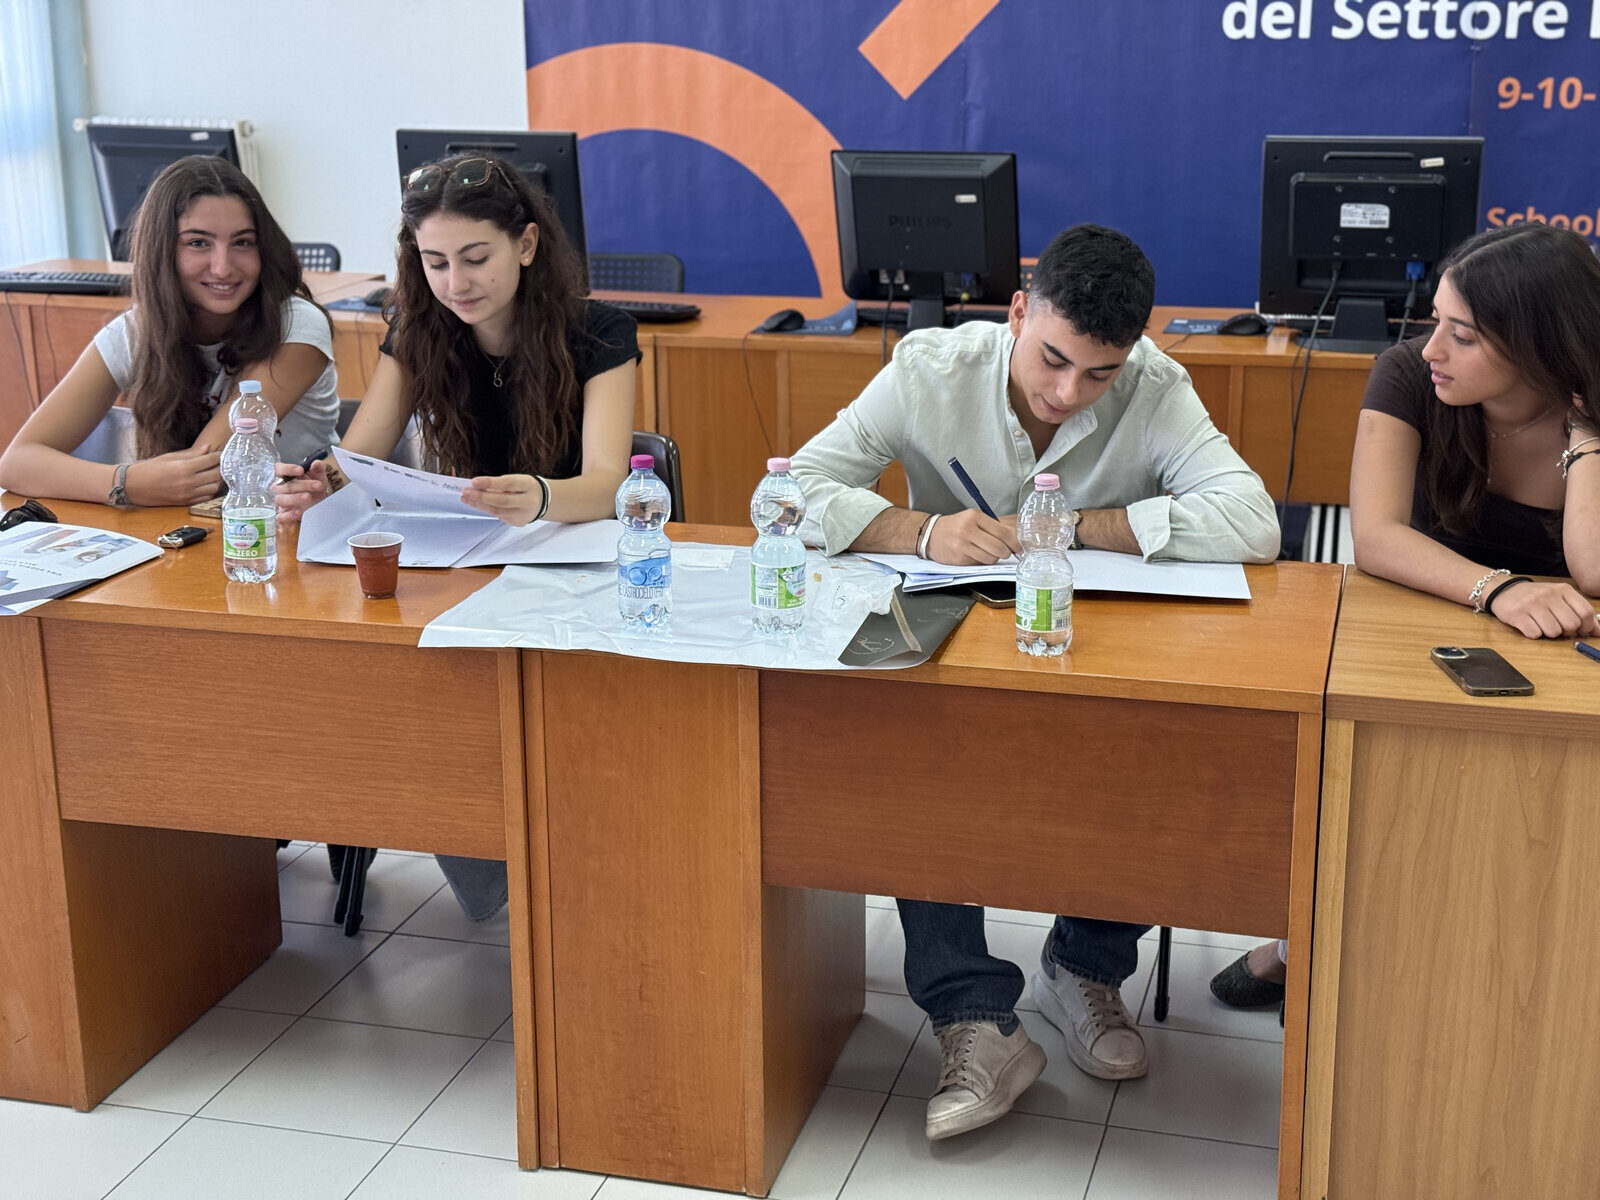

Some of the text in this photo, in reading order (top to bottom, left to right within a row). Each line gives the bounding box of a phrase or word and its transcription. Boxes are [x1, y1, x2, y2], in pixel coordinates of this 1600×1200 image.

[1222, 0, 1312, 40] del
[1331, 0, 1568, 40] Settore
[237, 550, 258, 558] ZERO
